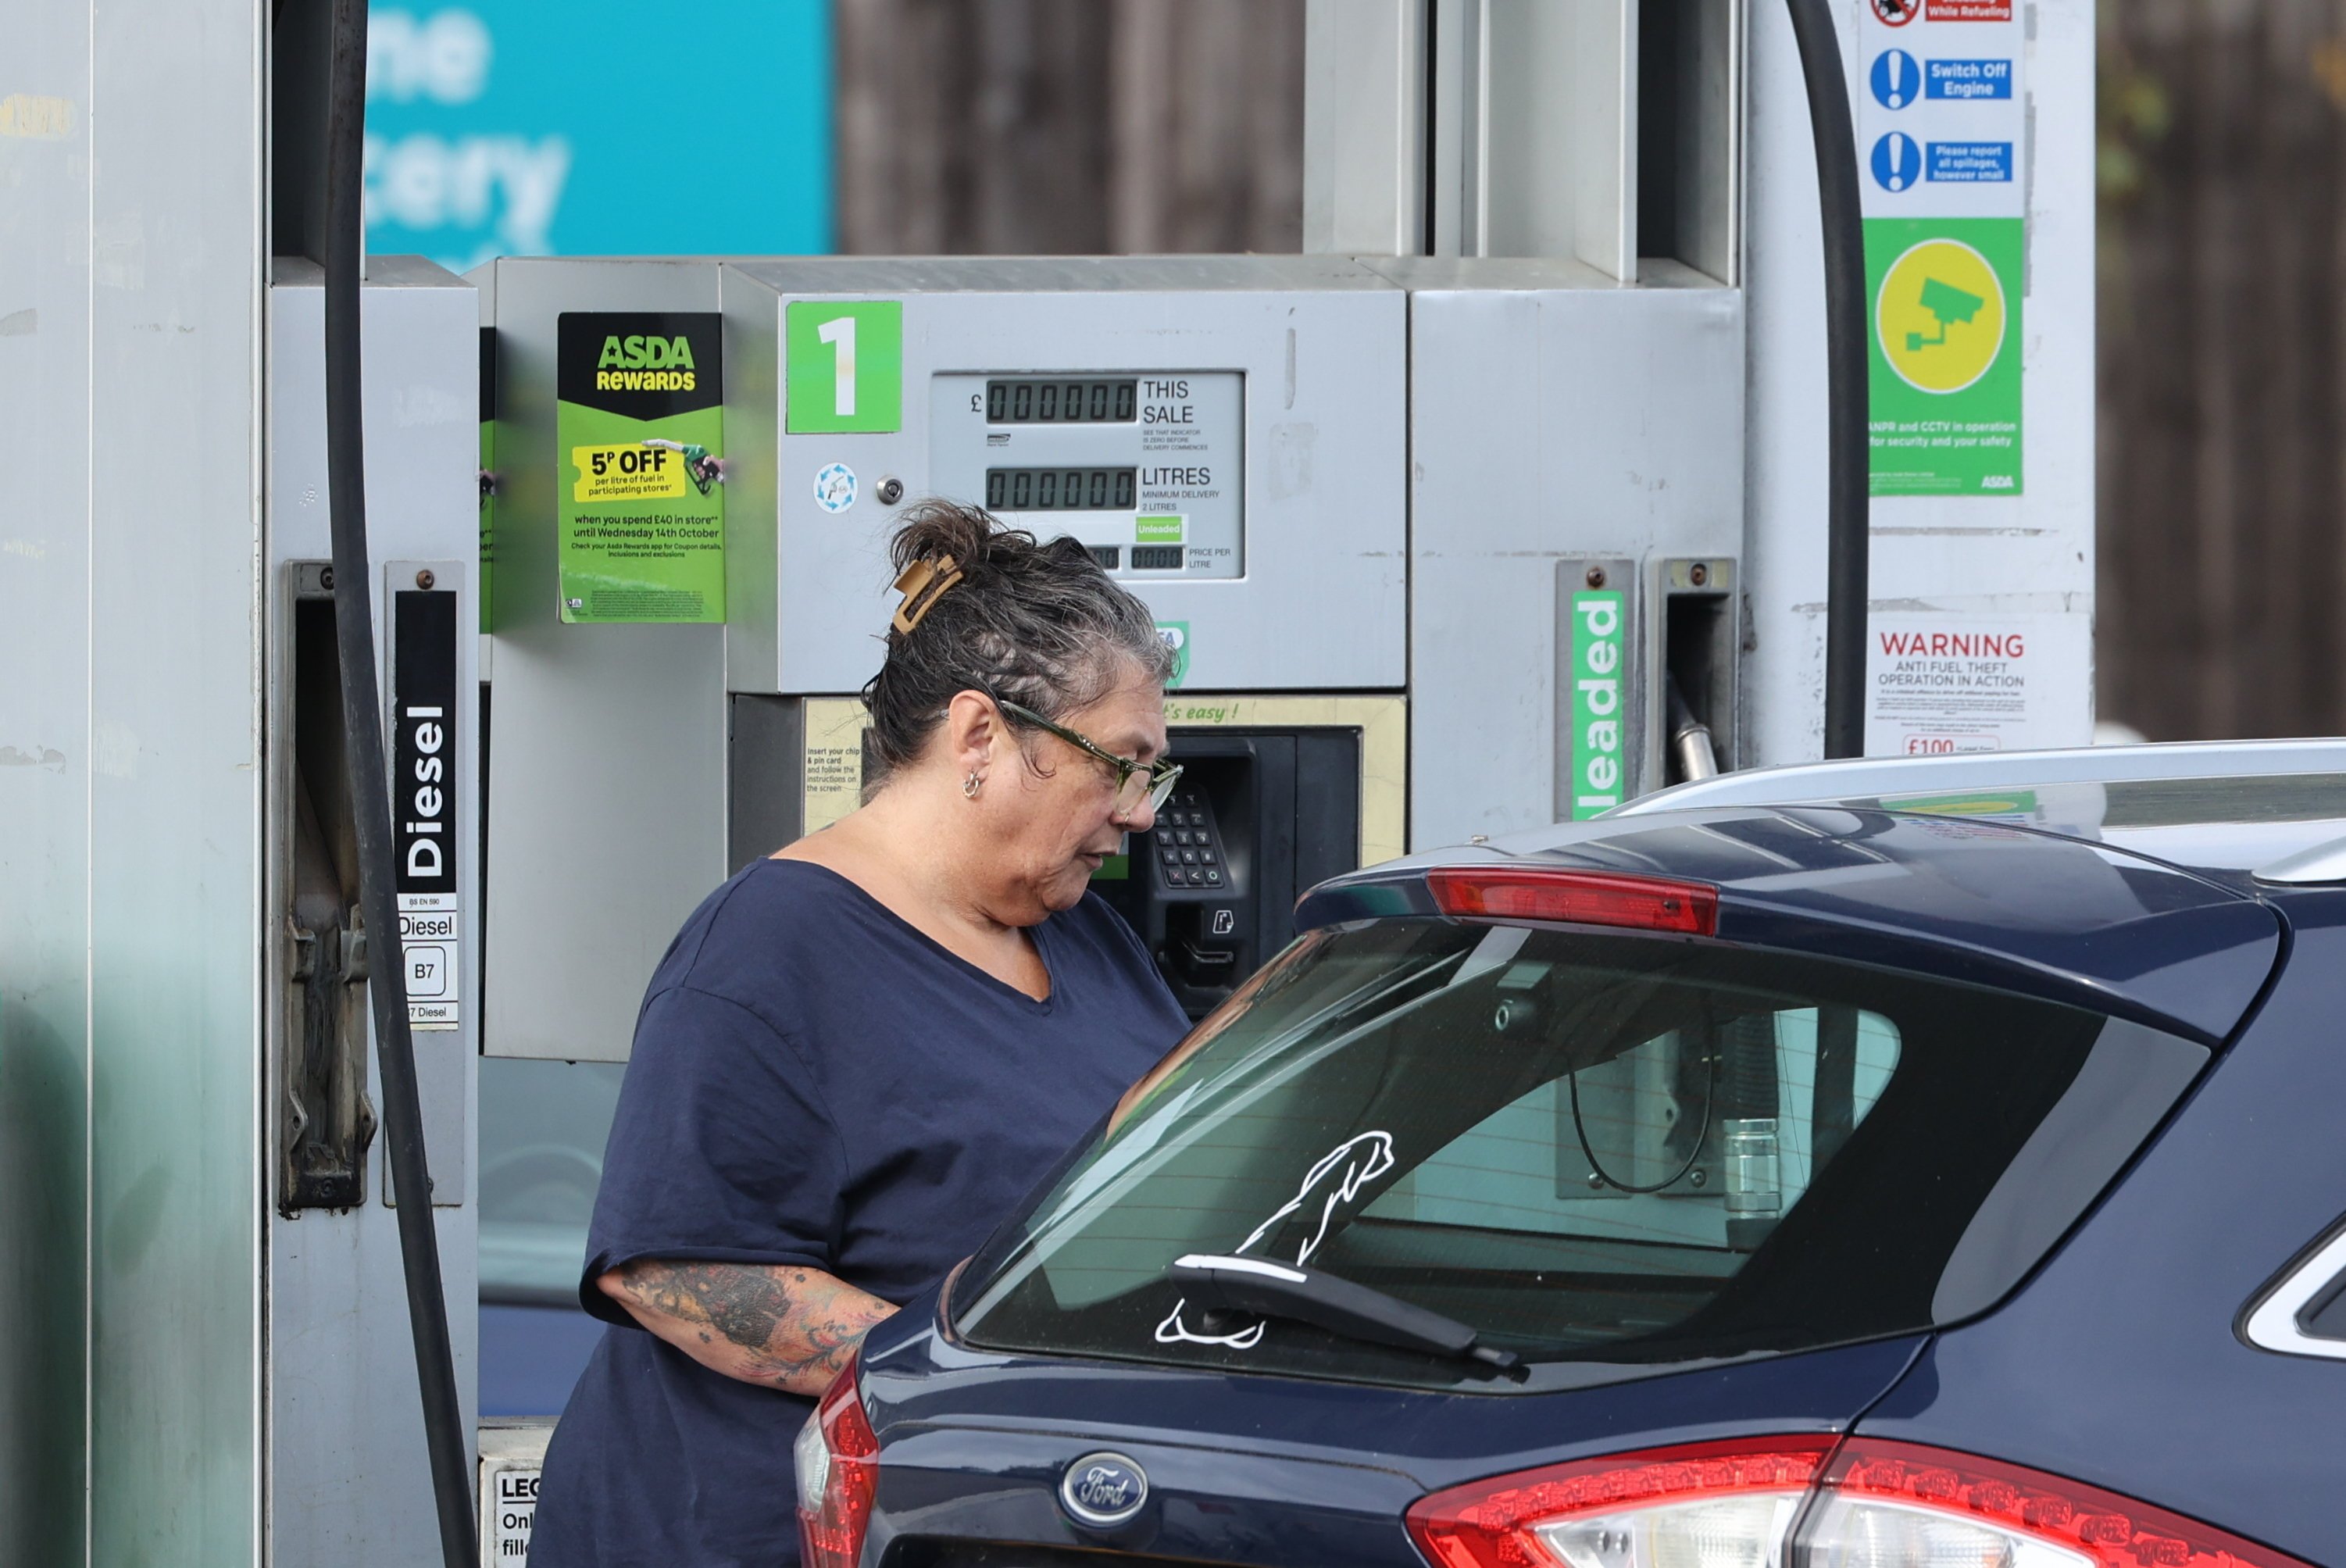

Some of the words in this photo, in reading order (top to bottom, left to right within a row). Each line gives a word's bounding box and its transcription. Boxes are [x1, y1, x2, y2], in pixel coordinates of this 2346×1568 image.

[1928, 5, 1959, 16] While
[1931, 63, 1980, 77] Switch
[1984, 63, 2007, 77] Off
[1944, 82, 1994, 98] Engine
[1936, 146, 1968, 156] Please
[1970, 146, 2001, 158] report
[1938, 159, 1951, 168] all
[1953, 159, 1999, 170] spillages,
[1934, 170, 1975, 180] however
[1978, 170, 2004, 180] small
[598, 335, 695, 370] ASDA
[818, 316, 855, 416] 1
[1144, 380, 1188, 399] THIS
[971, 394, 982, 413] £
[1144, 405, 1193, 424] SALE
[1898, 423, 1917, 431] and
[1920, 423, 1950, 431] CCTV
[1952, 422, 1962, 431] in
[1965, 423, 2016, 433] operation
[1887, 438, 1928, 448] security
[1931, 437, 1951, 445] and
[1954, 438, 1977, 448] your
[1980, 437, 2012, 448] safety
[620, 449, 666, 474] OFF
[595, 477, 609, 486] per
[611, 476, 628, 484] litre
[640, 474, 655, 483] fuel
[1143, 467, 1210, 485] LITRES
[1981, 475, 2013, 488] ASDA
[588, 484, 641, 497] participating
[575, 515, 601, 524] when
[603, 516, 620, 526] you
[623, 515, 652, 526] spend
[654, 515, 673, 524] £40
[675, 515, 683, 524] in
[573, 527, 596, 538] until
[598, 528, 654, 539] Wednesday
[655, 528, 677, 538] 14th
[679, 528, 719, 538] October
[1138, 524, 1180, 534] Unleaded
[1880, 632, 2024, 658] WARNING
[1896, 661, 1926, 673] ANTI
[1930, 662, 1963, 673] FUEL
[1968, 663, 2008, 674] THEFT
[1878, 674, 1954, 686] OPERATION
[1958, 675, 1970, 686] IN
[1975, 675, 2024, 688] ACTION
[1186, 707, 1225, 723] easy
[1232, 703, 1239, 719] !
[845, 748, 860, 756] chip
[406, 706, 443, 877] Diesel
[399, 916, 452, 935] Diesel
[415, 963, 434, 979] B7
[409, 1008, 416, 1017] 7
[419, 1006, 446, 1017] Diesel
[1080, 1466, 1129, 1505] Ford
